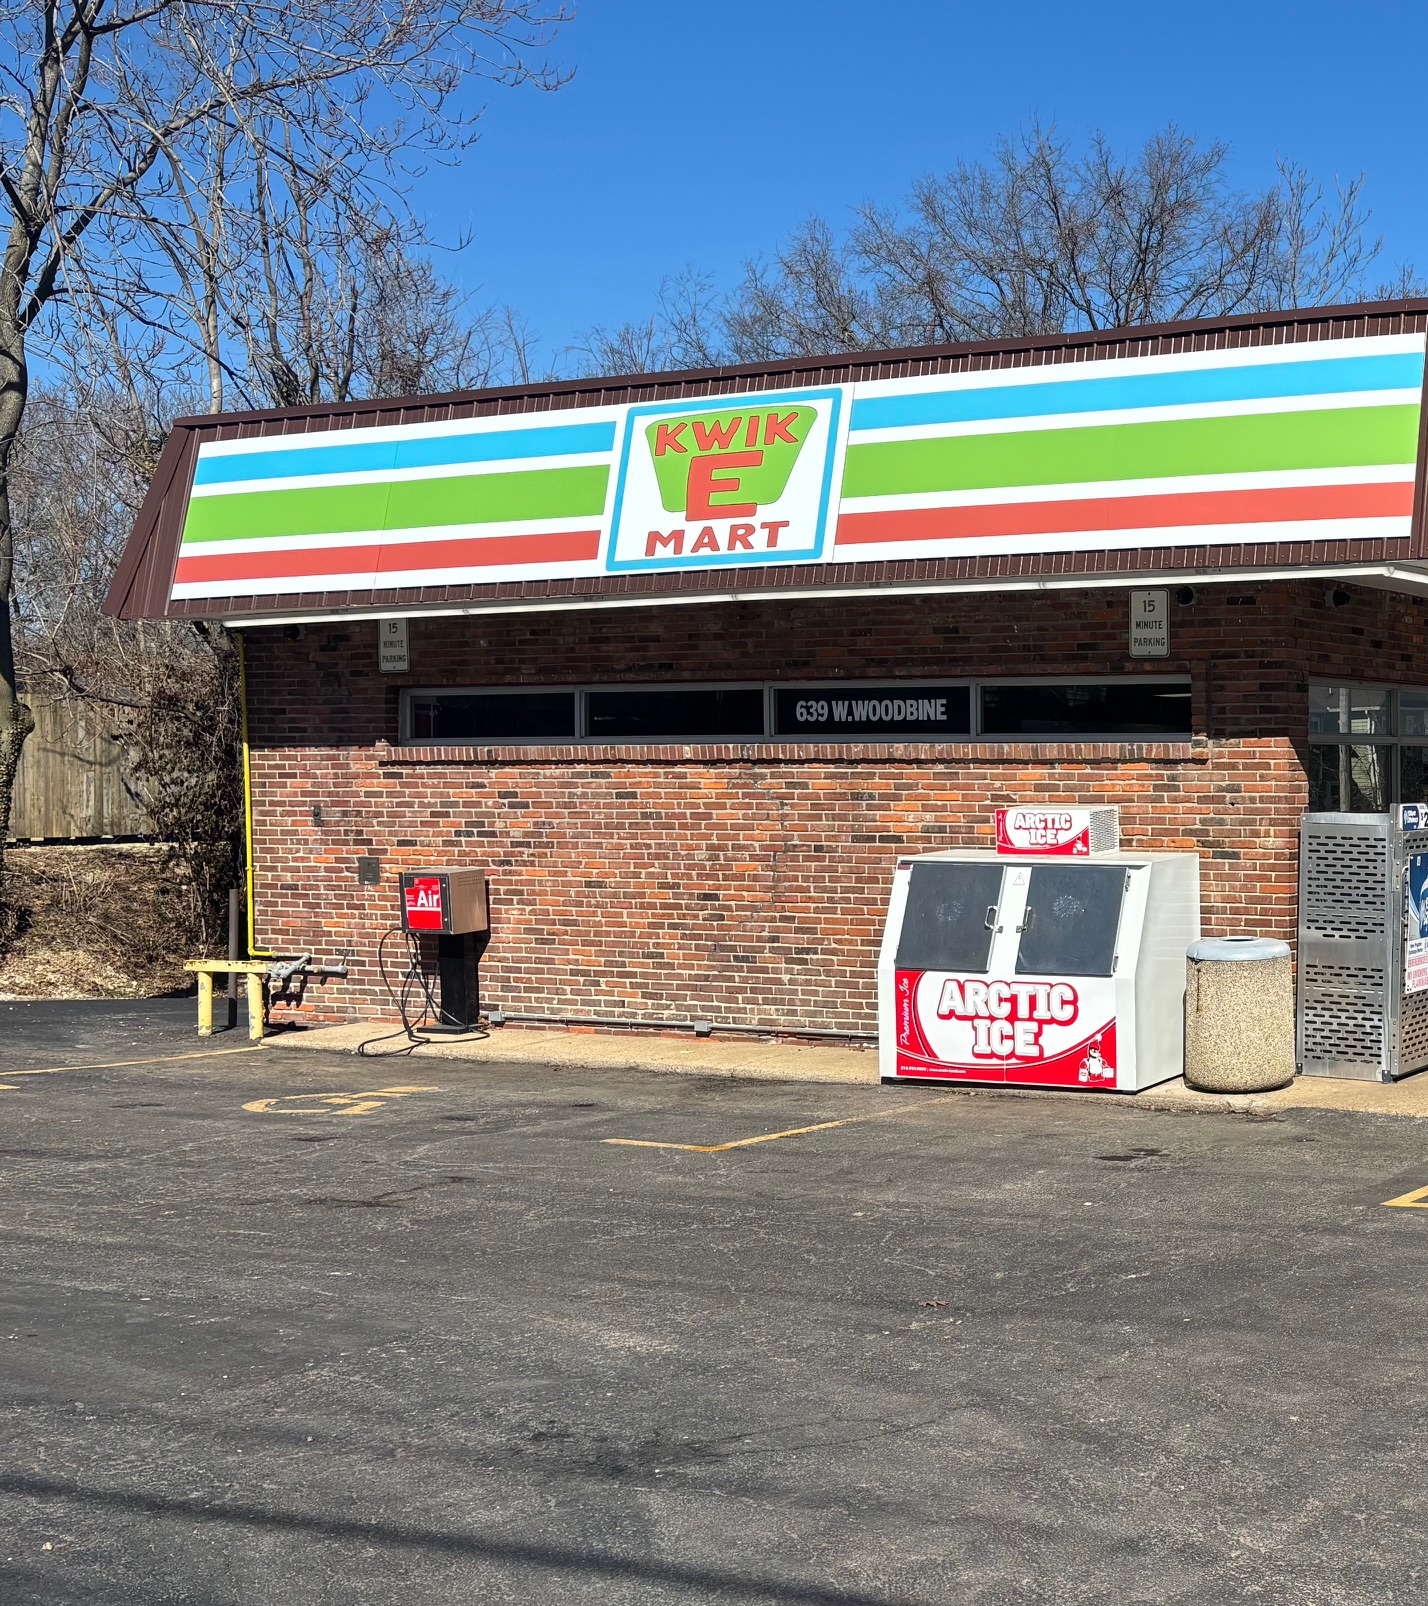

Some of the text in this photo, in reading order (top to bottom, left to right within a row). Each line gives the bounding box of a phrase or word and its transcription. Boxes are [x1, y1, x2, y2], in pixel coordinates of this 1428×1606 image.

[655, 412, 799, 456] KWIK
[685, 450, 763, 522] E
[645, 520, 790, 557] MART
[1142, 600, 1156, 613] 15
[388, 623, 398, 634] 15
[1135, 620, 1163, 630] MINUTE
[383, 640, 404, 649] MINUTE
[1133, 637, 1166, 647] PARKING
[381, 654, 407, 663] PARKING
[796, 700, 828, 722] 639
[1014, 812, 1073, 831] ARCTIC
[1029, 828, 1059, 846] ICE
[417, 889, 439, 907] Air
[936, 978, 1079, 1026] ARCTIC
[898, 977, 910, 1046] Premium Ice
[971, 1018, 1043, 1061] ICE
